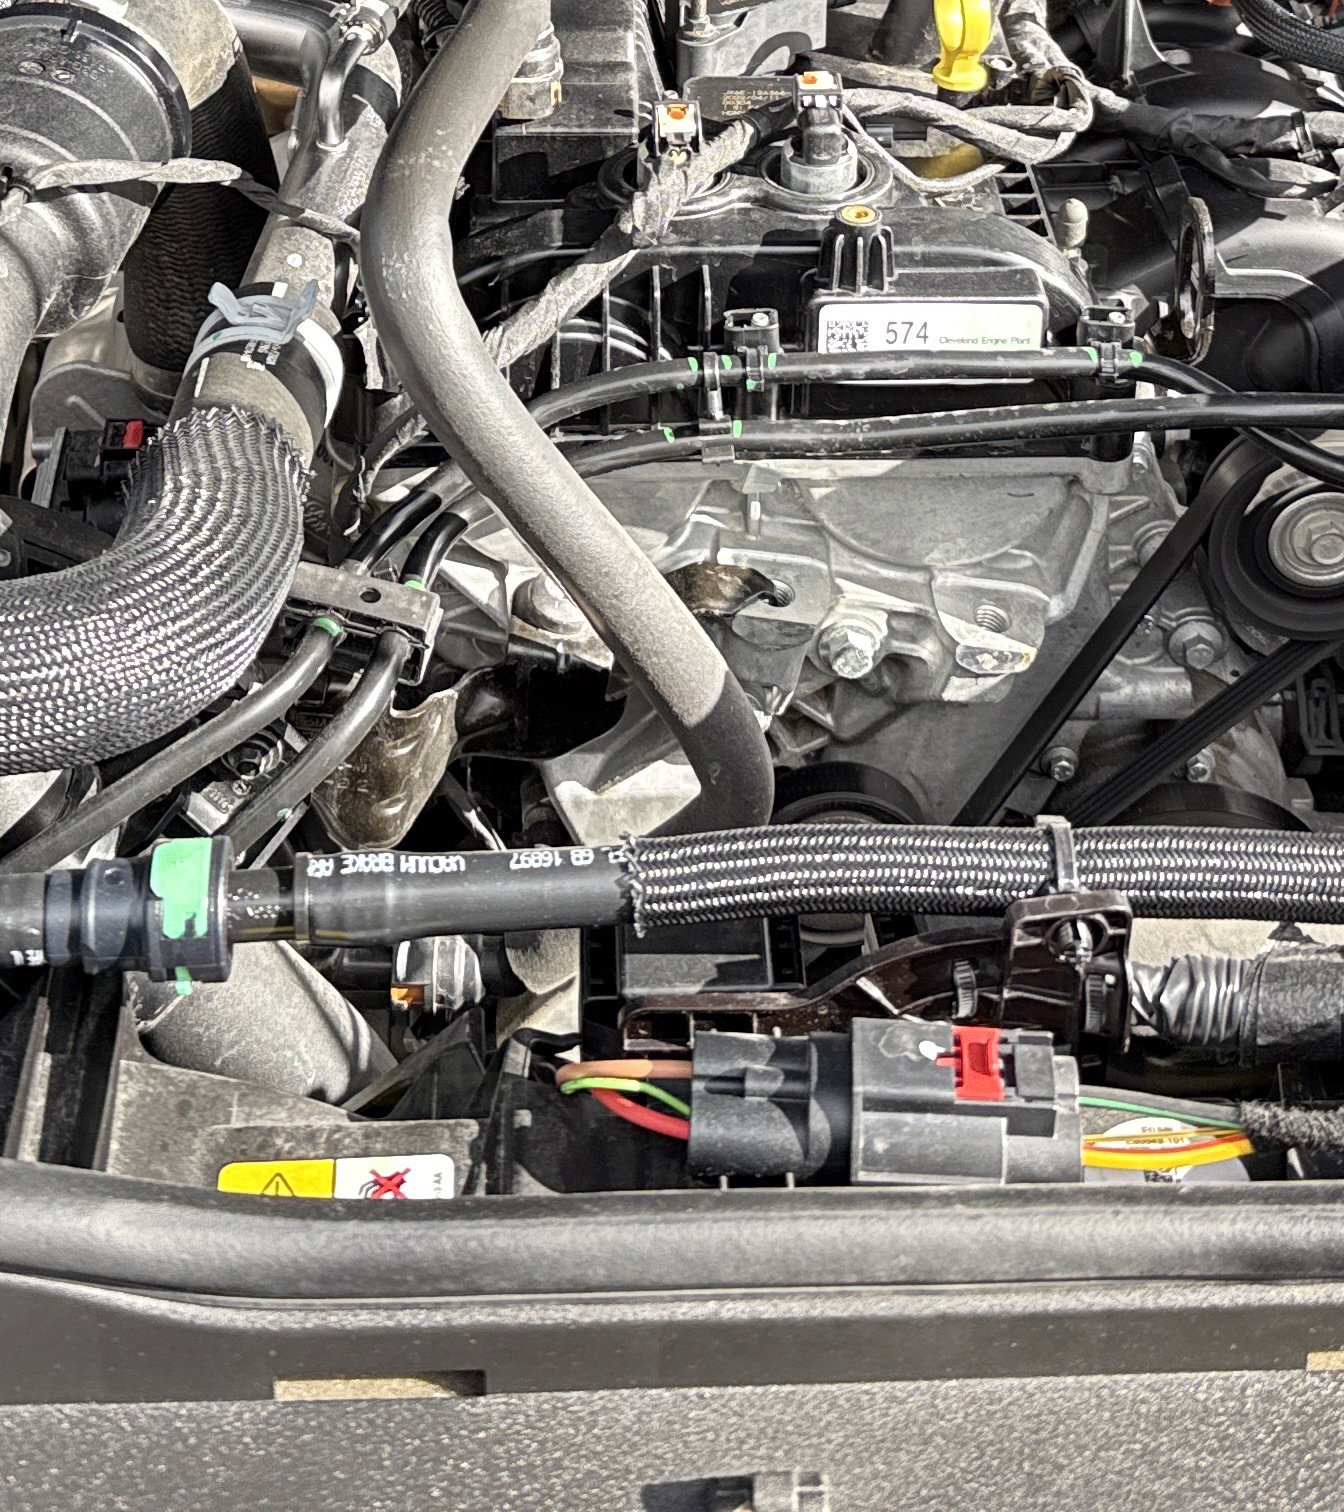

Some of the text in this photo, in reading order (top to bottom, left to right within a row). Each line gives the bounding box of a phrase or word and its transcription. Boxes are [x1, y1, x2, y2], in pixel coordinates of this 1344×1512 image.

[885, 321, 929, 345] 574
[939, 336, 1031, 346] Cleveland Engine Plant
[339, 853, 395, 875] BRAKE
[509, 850, 563, 870] 16897
